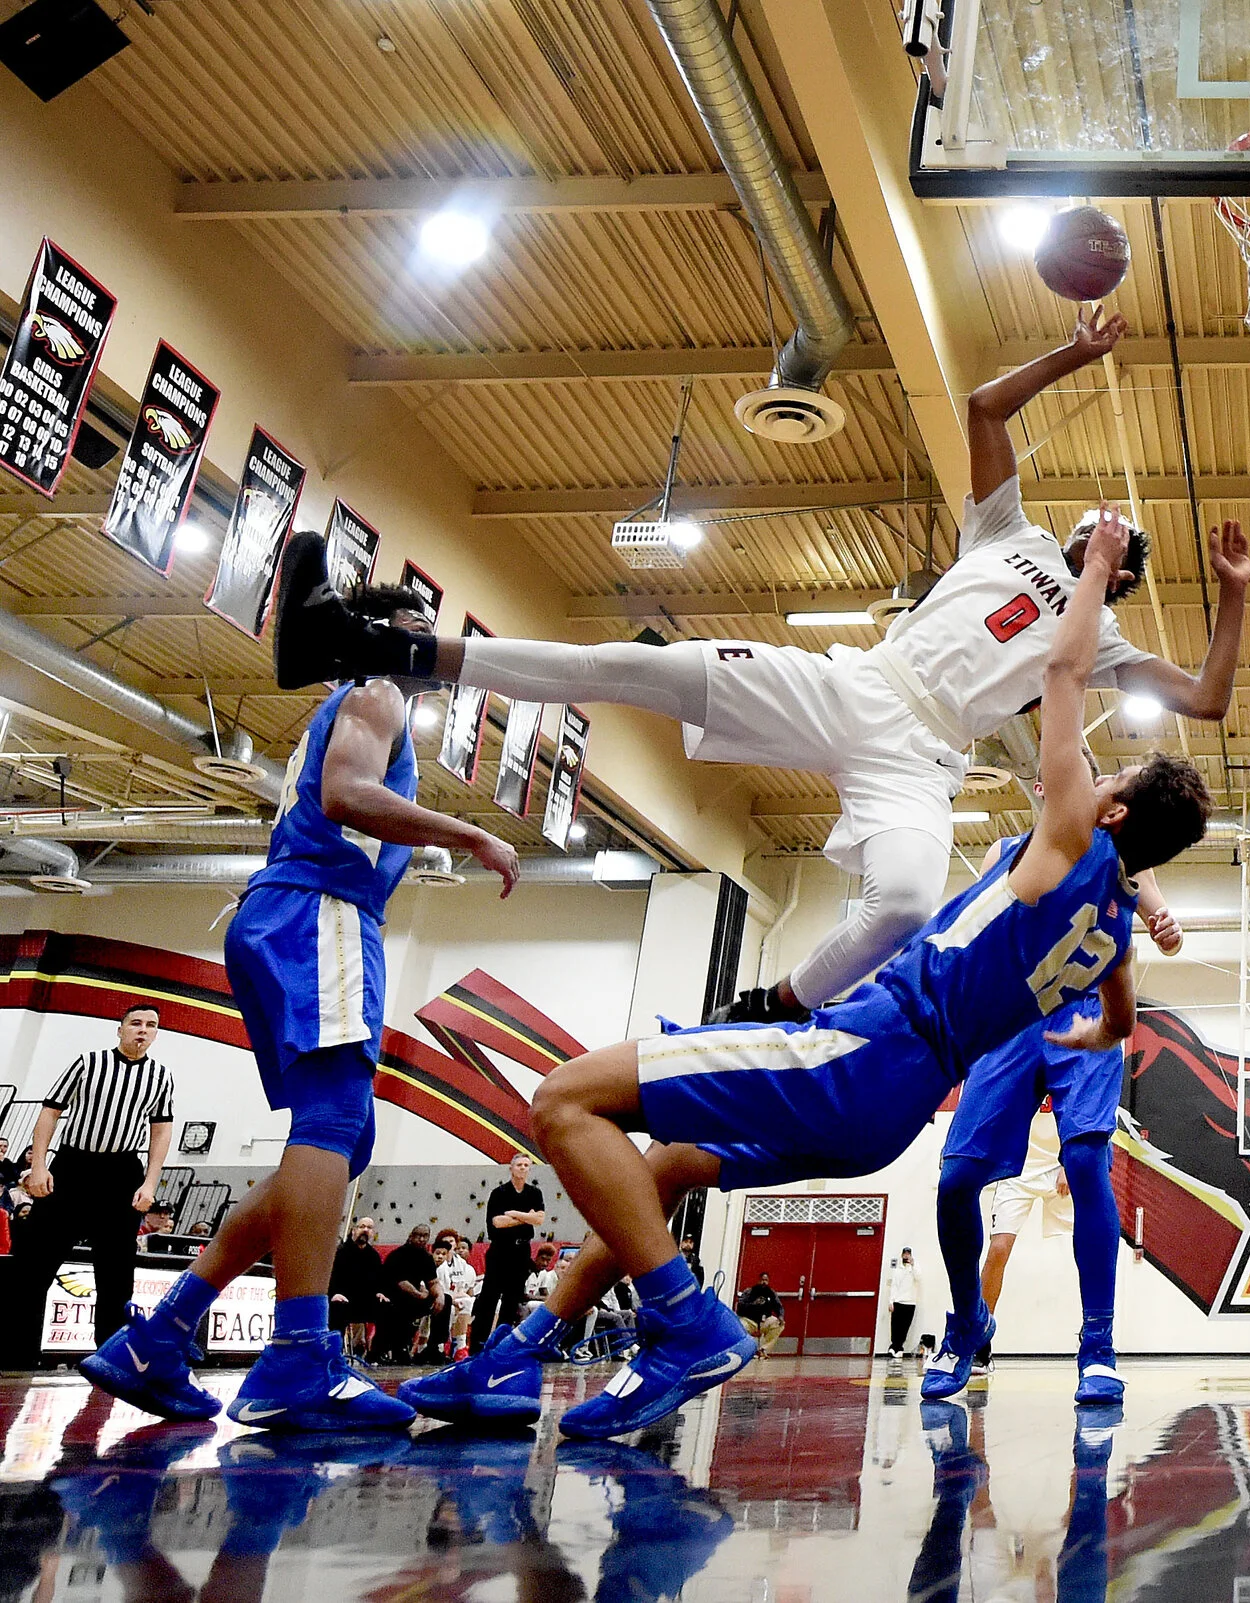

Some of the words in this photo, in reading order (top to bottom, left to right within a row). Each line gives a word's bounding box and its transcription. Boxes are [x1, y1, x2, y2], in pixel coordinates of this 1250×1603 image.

[38, 274, 103, 339] CHAMPIONS
[56, 265, 97, 310] LEAGUE
[10, 360, 70, 416] BASKETBALL
[33, 357, 63, 388] GIRLS
[168, 363, 203, 403] LEAGUE
[14, 389, 29, 408] 02
[28, 399, 43, 418] 03
[54, 420, 69, 438] 05
[152, 372, 207, 428] CHAMPIONS
[0, 399, 8, 415] 6
[7, 405, 23, 423] 07
[22, 416, 37, 435] 08
[49, 436, 62, 453] 10
[2, 423, 16, 441] 12
[18, 435, 31, 452] 13
[44, 454, 58, 470] 15
[249, 455, 296, 502] CHAMPIONS
[263, 446, 292, 480] LEAGUE
[344, 516, 369, 547] LEAGUE
[411, 575, 434, 603] LEAGUE
[984, 592, 1041, 644] 0
[716, 647, 755, 662] E
